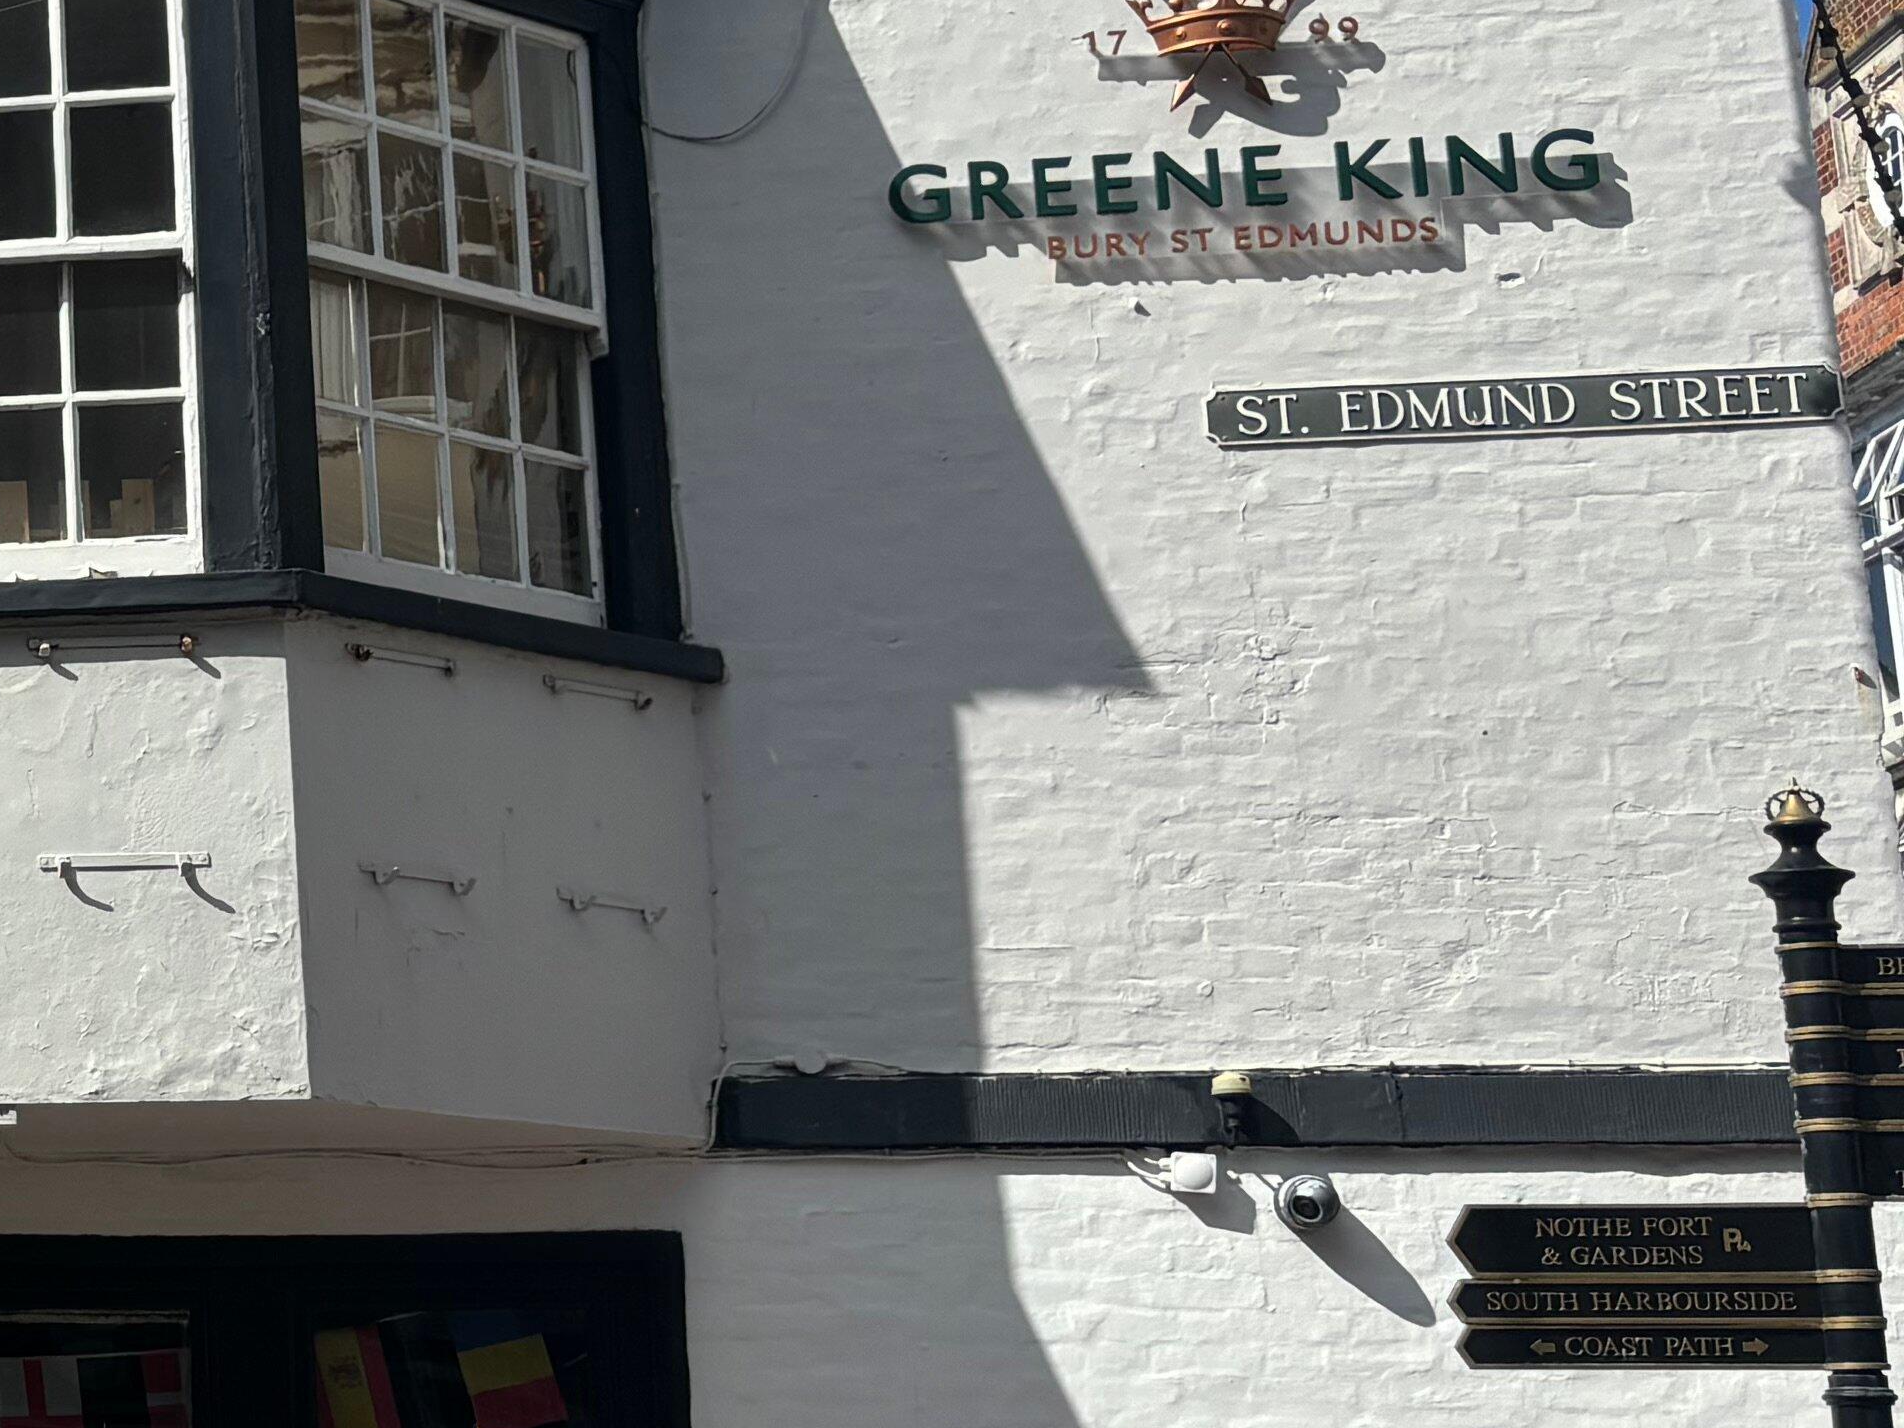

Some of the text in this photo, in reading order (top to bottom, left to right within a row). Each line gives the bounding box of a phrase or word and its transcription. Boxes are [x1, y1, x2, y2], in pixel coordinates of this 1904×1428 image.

[888, 128, 1601, 224] GREENE KING
[1047, 217, 1439, 260] BURY ST EDMUNDS
[1235, 372, 1807, 436] ST. EDMUND STREET
[1535, 1216, 1712, 1238] NOTHE FORT
[1540, 1245, 1704, 1266] & GARDENS
[1486, 1291, 1797, 1312] SOUTH HARBOURSIDE
[1564, 1336, 1735, 1358] COAST PATH
